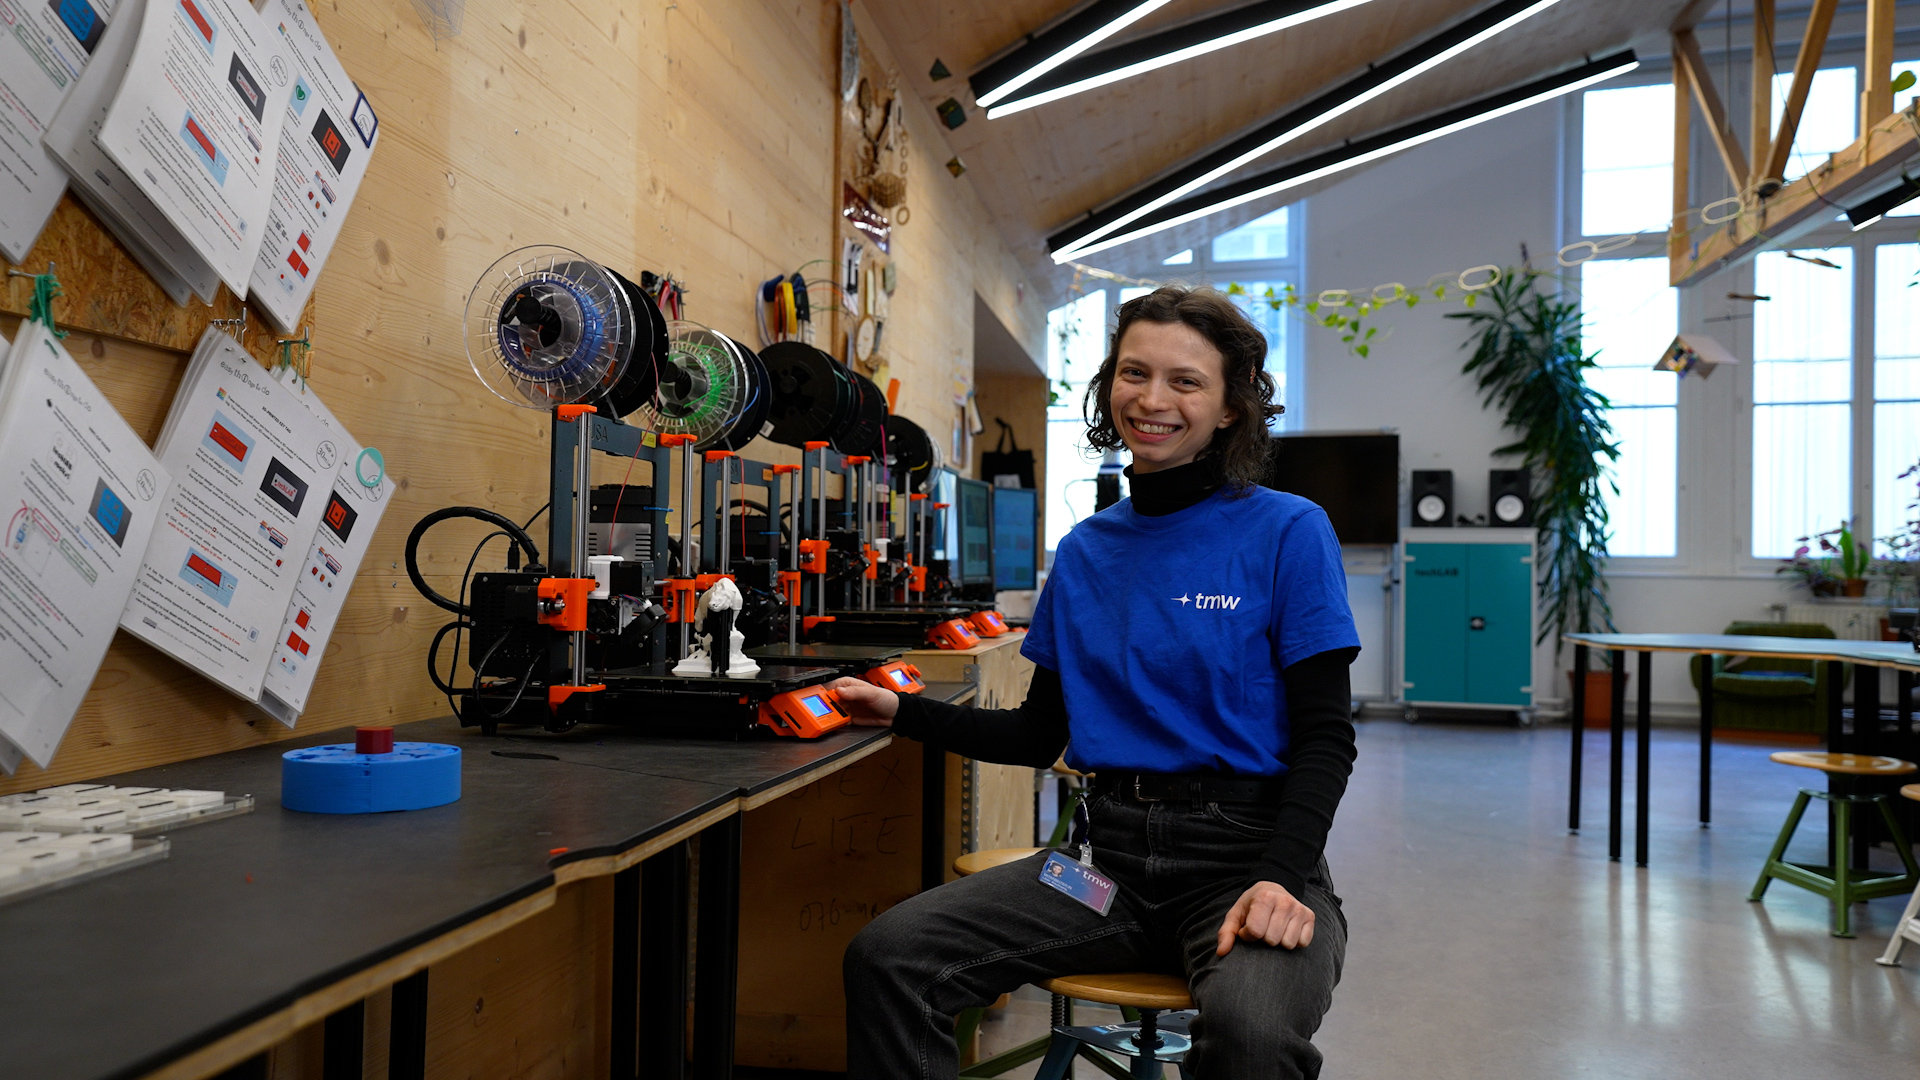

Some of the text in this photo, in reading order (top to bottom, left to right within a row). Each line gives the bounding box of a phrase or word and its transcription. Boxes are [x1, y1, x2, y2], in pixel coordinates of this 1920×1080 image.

[220, 360, 233, 376] easy
[261, 386, 270, 396] do
[1196, 592, 1242, 610] tmw
[792, 812, 913, 854] LITE
[1082, 870, 1110, 890] tmw
